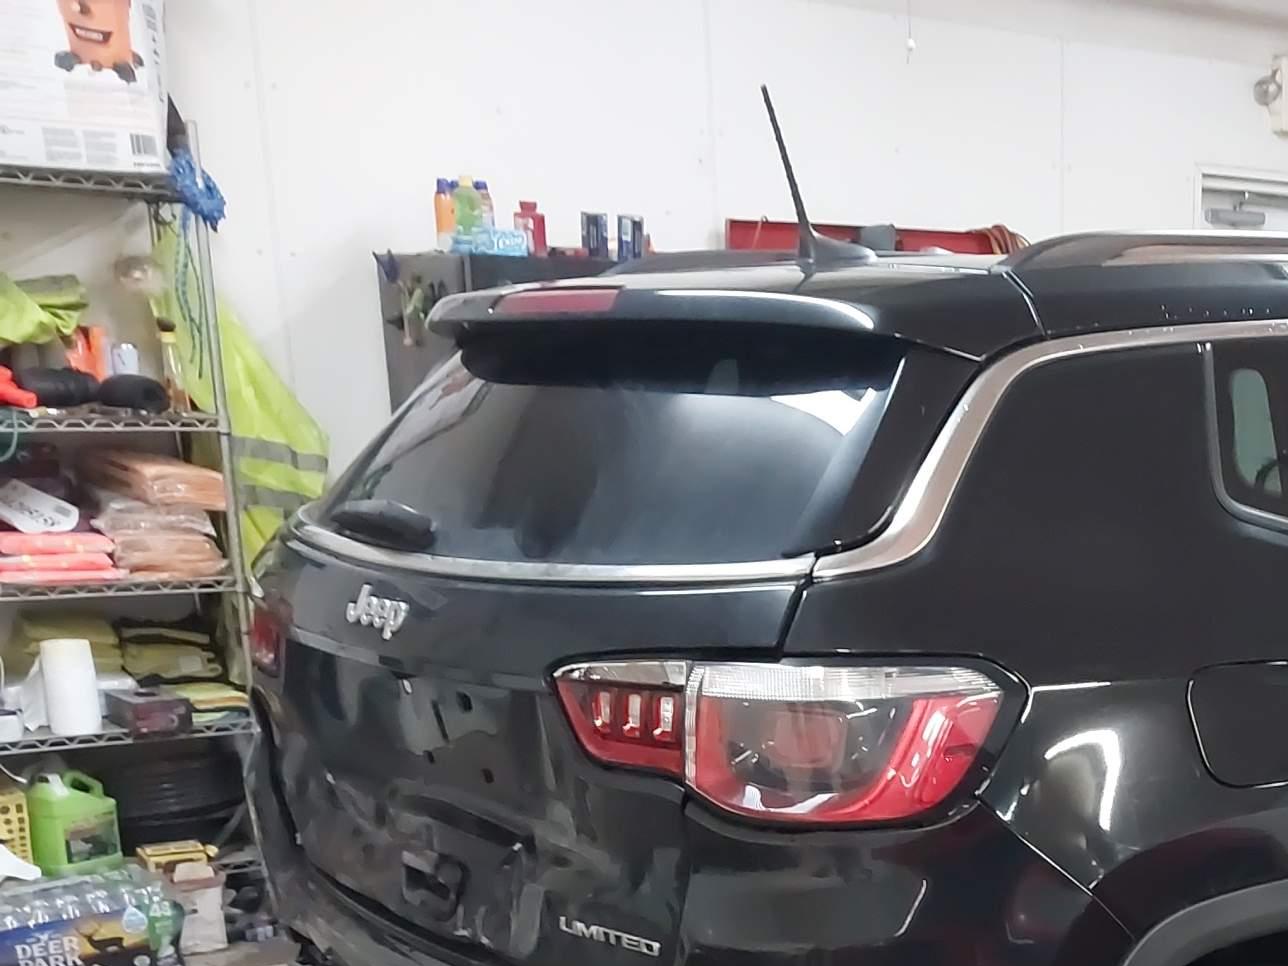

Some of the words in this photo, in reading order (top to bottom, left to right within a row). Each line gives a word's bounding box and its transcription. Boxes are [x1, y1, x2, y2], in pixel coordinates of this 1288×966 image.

[346, 583, 410, 641] Jeep
[14, 936, 79, 959] DEER
[558, 915, 662, 957] LIMITED
